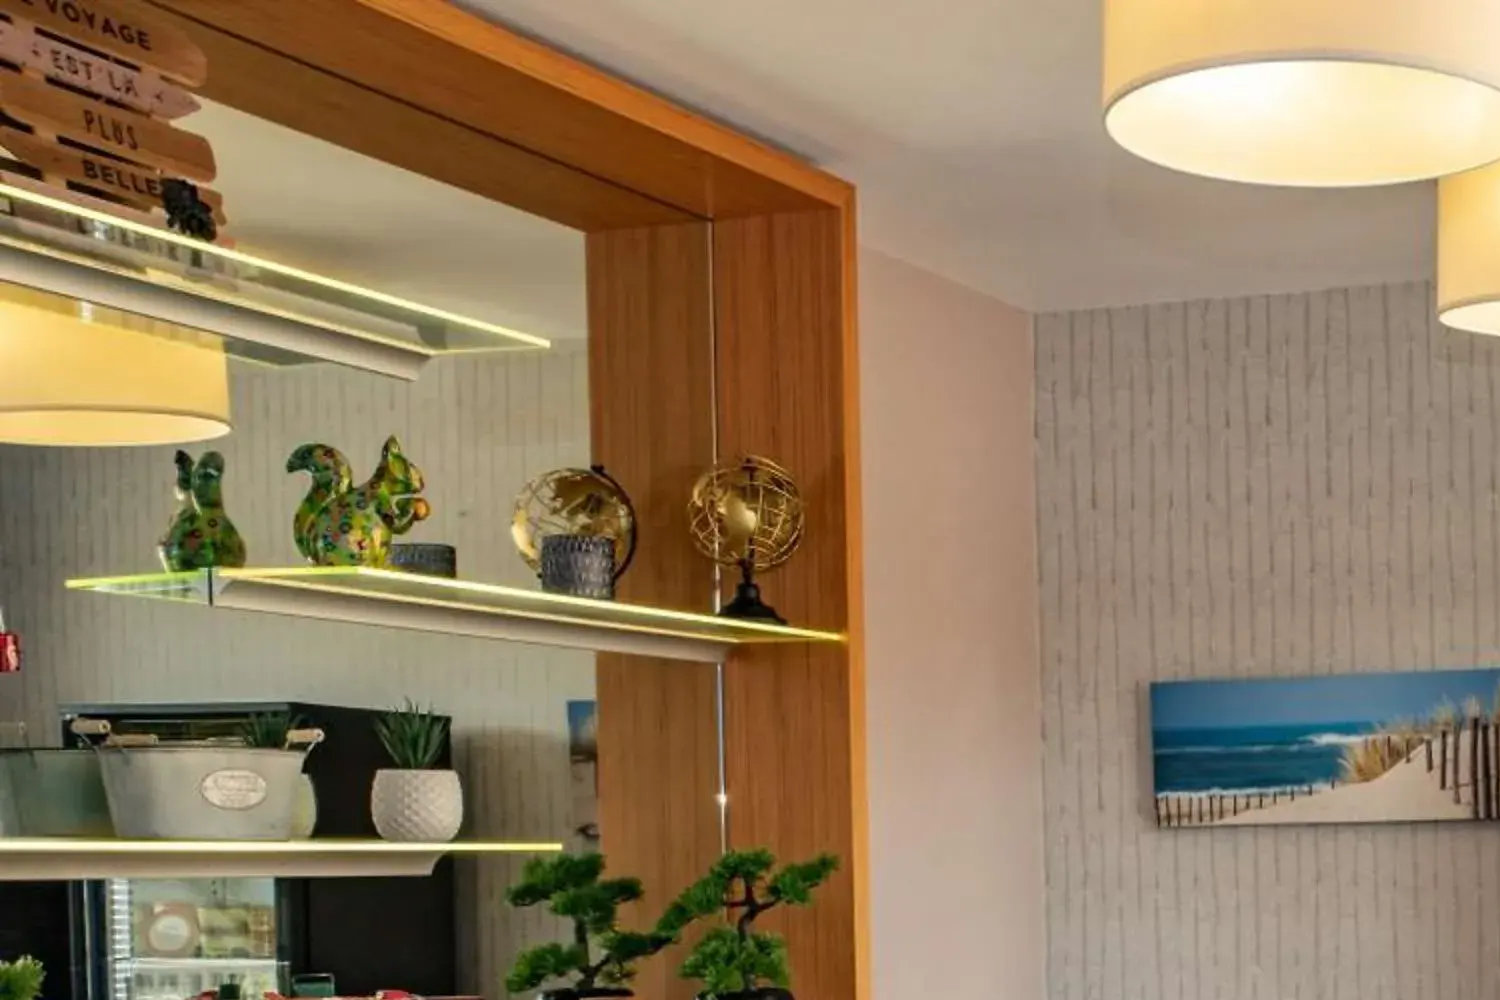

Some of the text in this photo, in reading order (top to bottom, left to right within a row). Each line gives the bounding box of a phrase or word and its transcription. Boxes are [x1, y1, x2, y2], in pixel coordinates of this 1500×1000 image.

[45, 0, 152, 51] VOYAGE
[51, 50, 93, 81] EST
[83, 109, 138, 150] PLUS
[82, 158, 162, 197] BELLE
